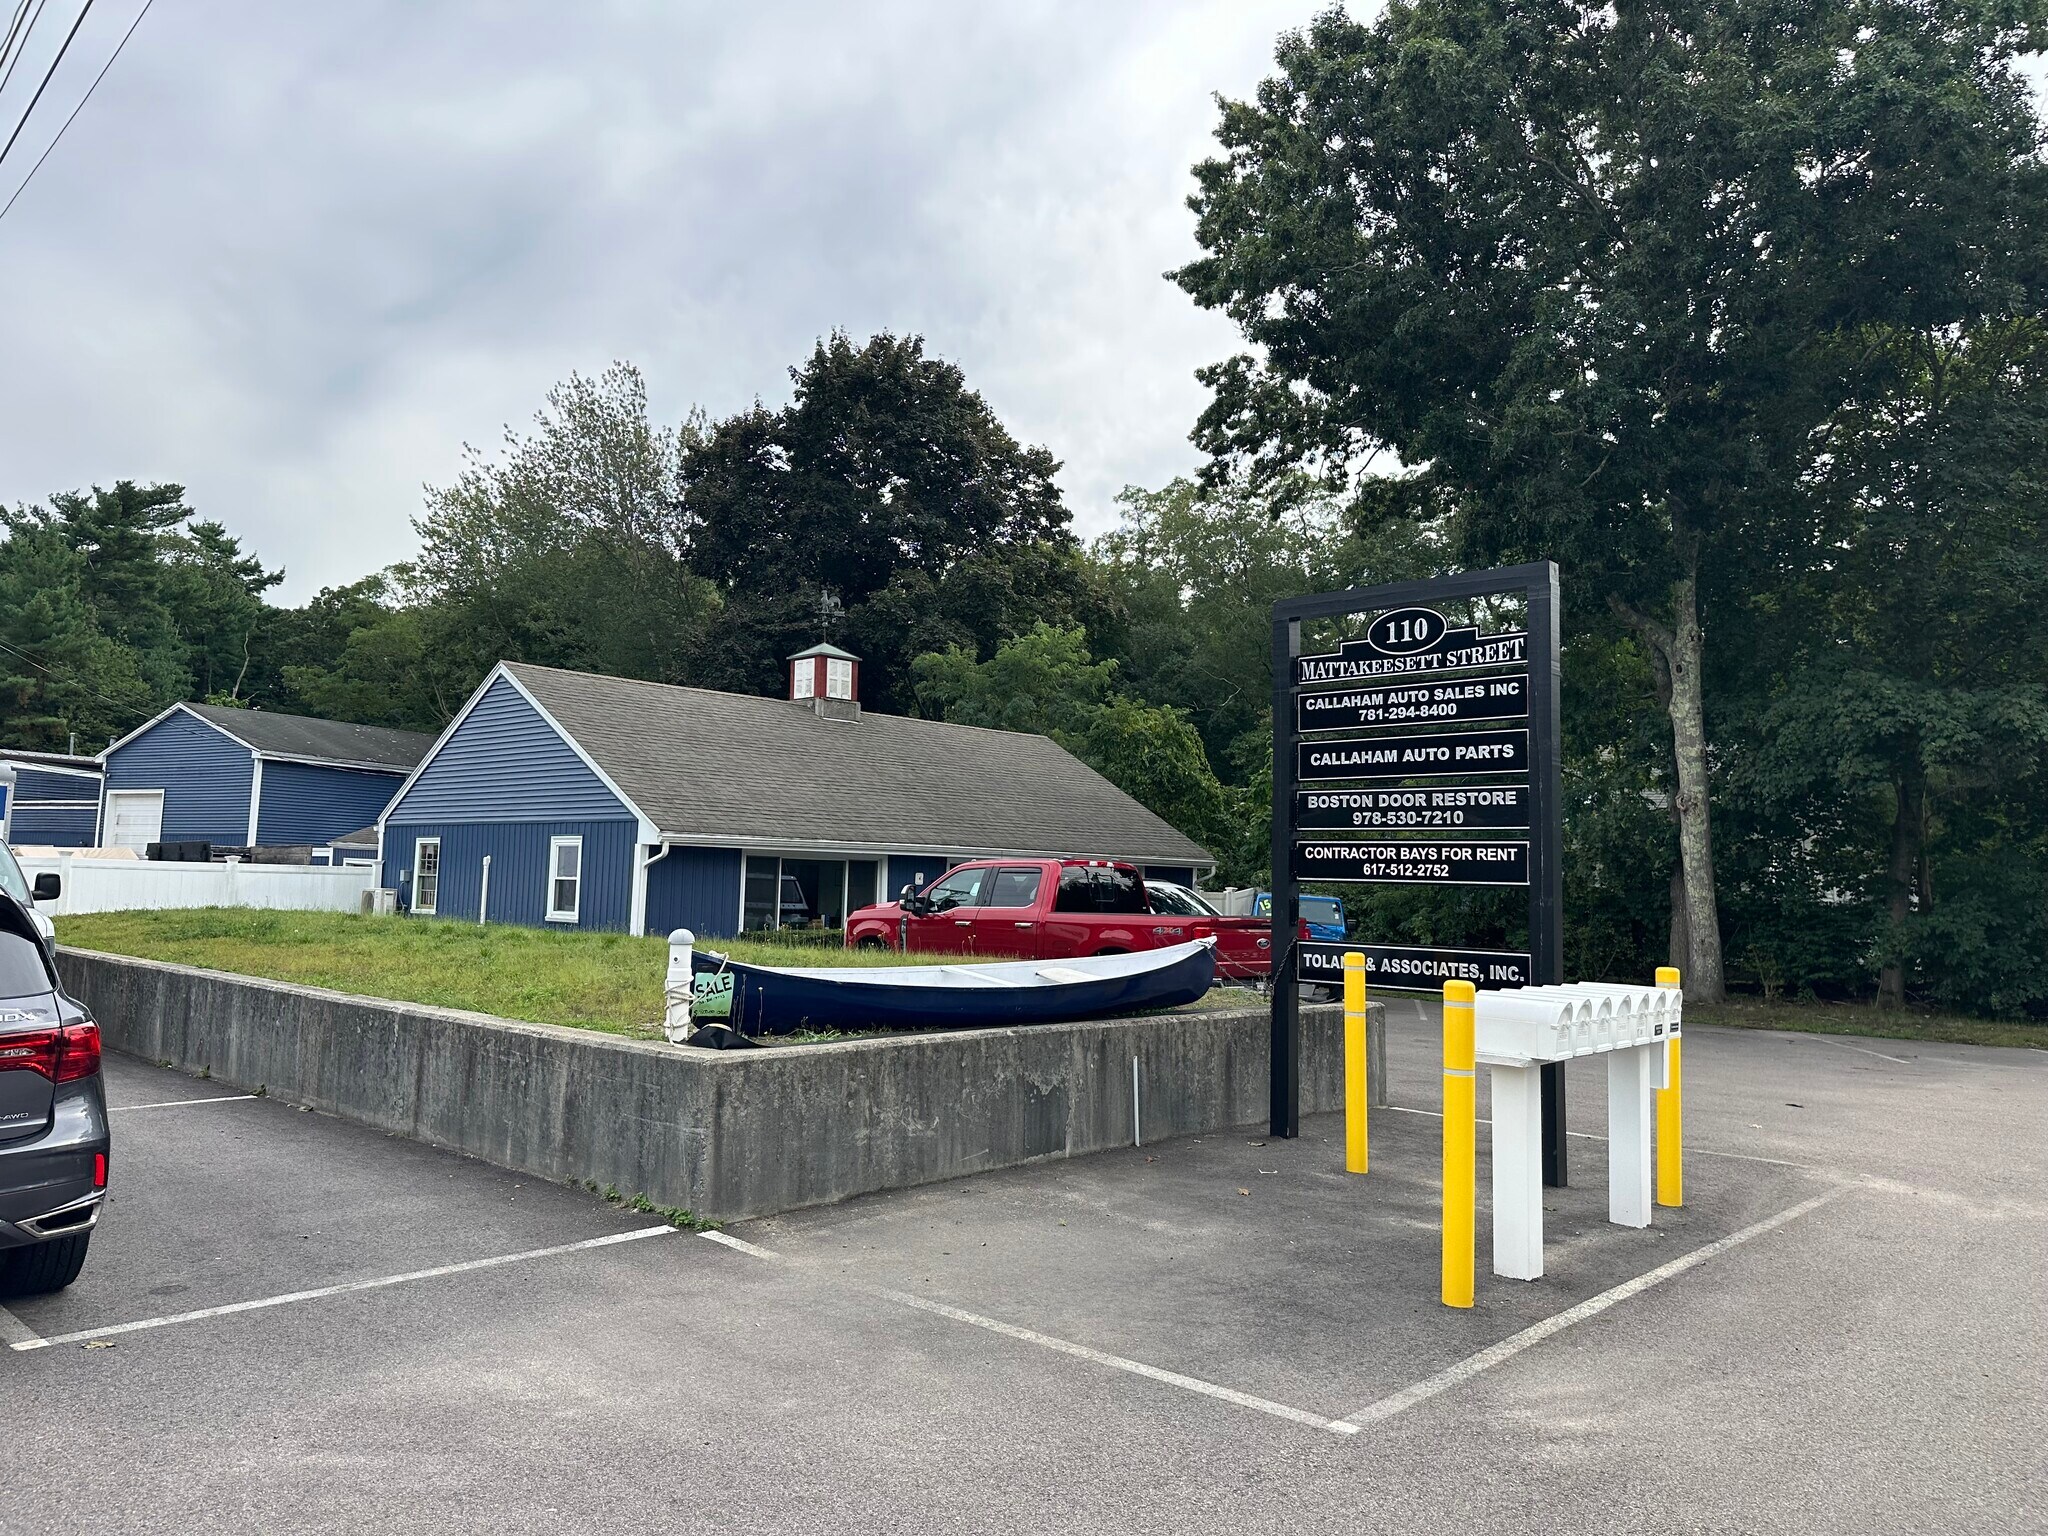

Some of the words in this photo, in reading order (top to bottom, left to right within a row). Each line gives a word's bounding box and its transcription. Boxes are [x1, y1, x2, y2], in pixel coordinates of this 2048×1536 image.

[1385, 617, 1428, 644] 110
[1301, 653, 1442, 680] MATTAKEESETT
[1446, 637, 1524, 666] STREET
[1305, 693, 1384, 711] CALLAHAM
[1387, 689, 1430, 705] AUTO
[1433, 685, 1485, 700] SALES
[1490, 682, 1520, 696] INC
[1358, 703, 1457, 722] 781-294-8400
[1310, 749, 1398, 766] CALLAHAM
[1402, 746, 1450, 762] AUTO
[1455, 743, 1515, 760] PARTS
[1307, 794, 1373, 809] BOSTON
[1378, 793, 1427, 807] DOOR
[1432, 791, 1517, 806] RESTORE
[1352, 810, 1464, 825] 978-530-7210
[1305, 847, 1397, 860] CONTRACTOR
[1400, 847, 1438, 860] BAYS
[1441, 848, 1473, 861] FOR
[1476, 848, 1518, 862] RENT
[1363, 863, 1449, 877] 617-512-2752
[1303, 953, 1345, 969] TOLA
[1365, 958, 1376, 972] &
[1380, 958, 1485, 982] ASSOCIATES,
[1489, 965, 1525, 982] INC.
[695, 975, 732, 998] SALE
